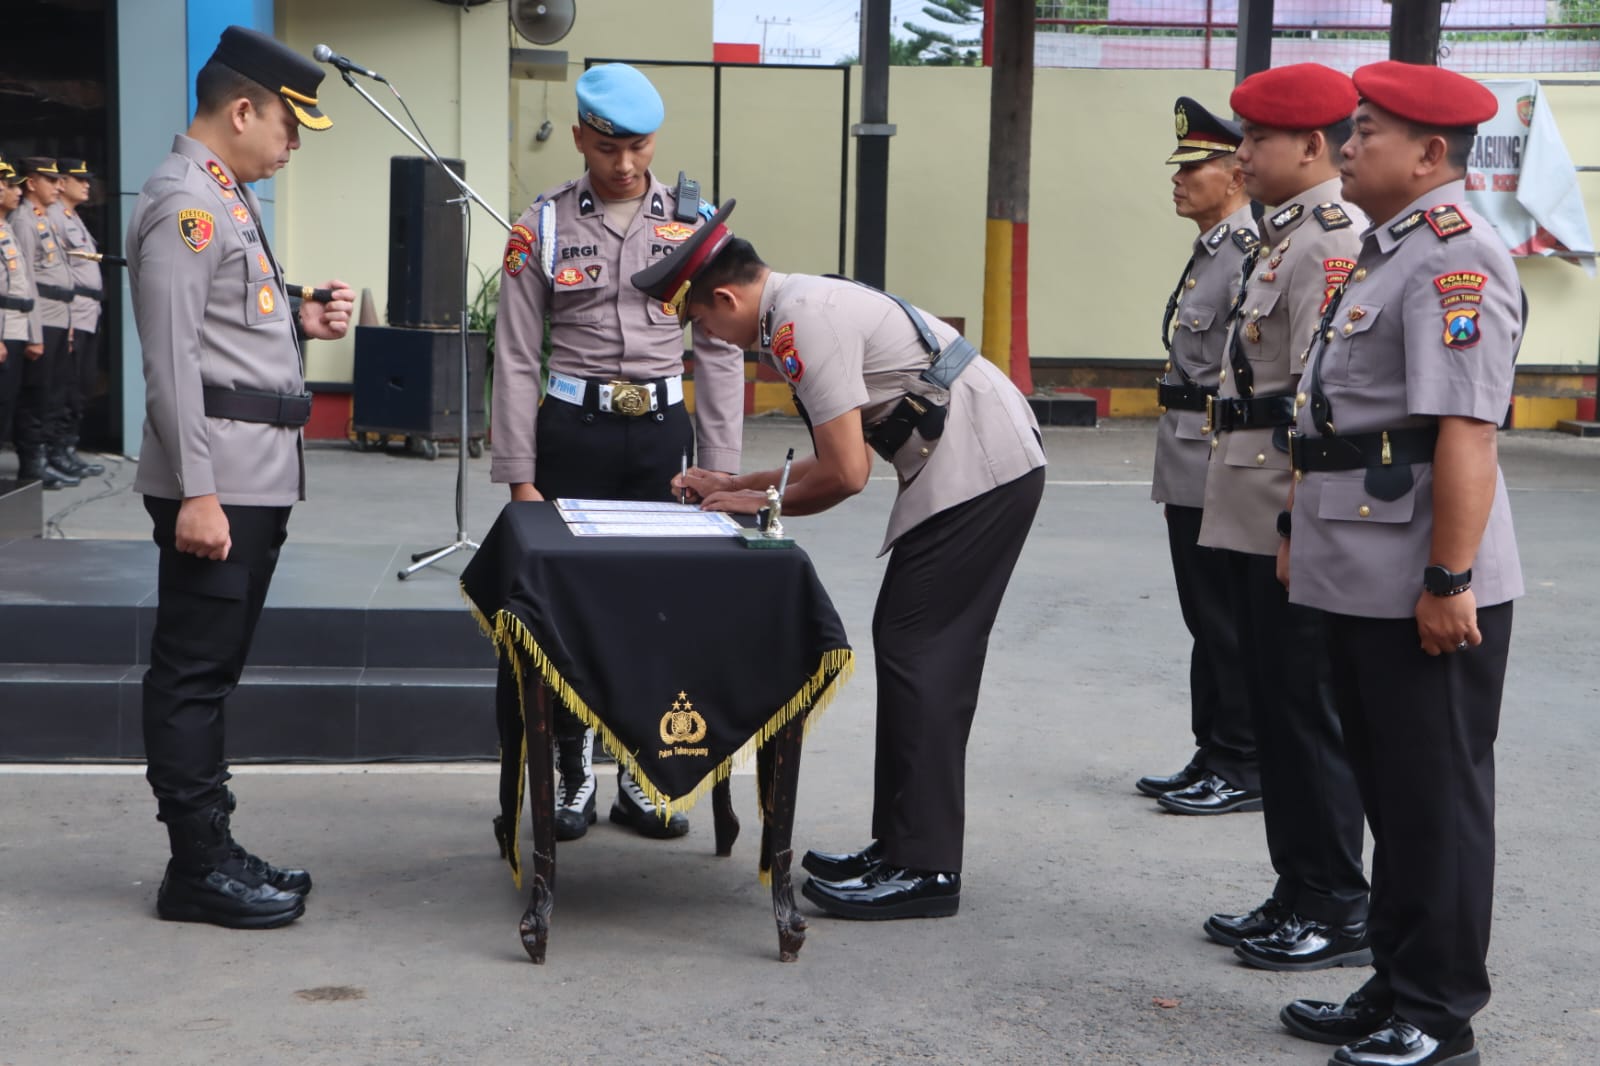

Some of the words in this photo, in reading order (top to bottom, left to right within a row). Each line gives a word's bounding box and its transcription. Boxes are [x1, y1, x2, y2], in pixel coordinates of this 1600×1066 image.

[1467, 135, 1521, 169] AGUNG
[561, 245, 598, 259] ERGI
[1328, 260, 1354, 270] POLD
[1440, 273, 1483, 286] POLRES
